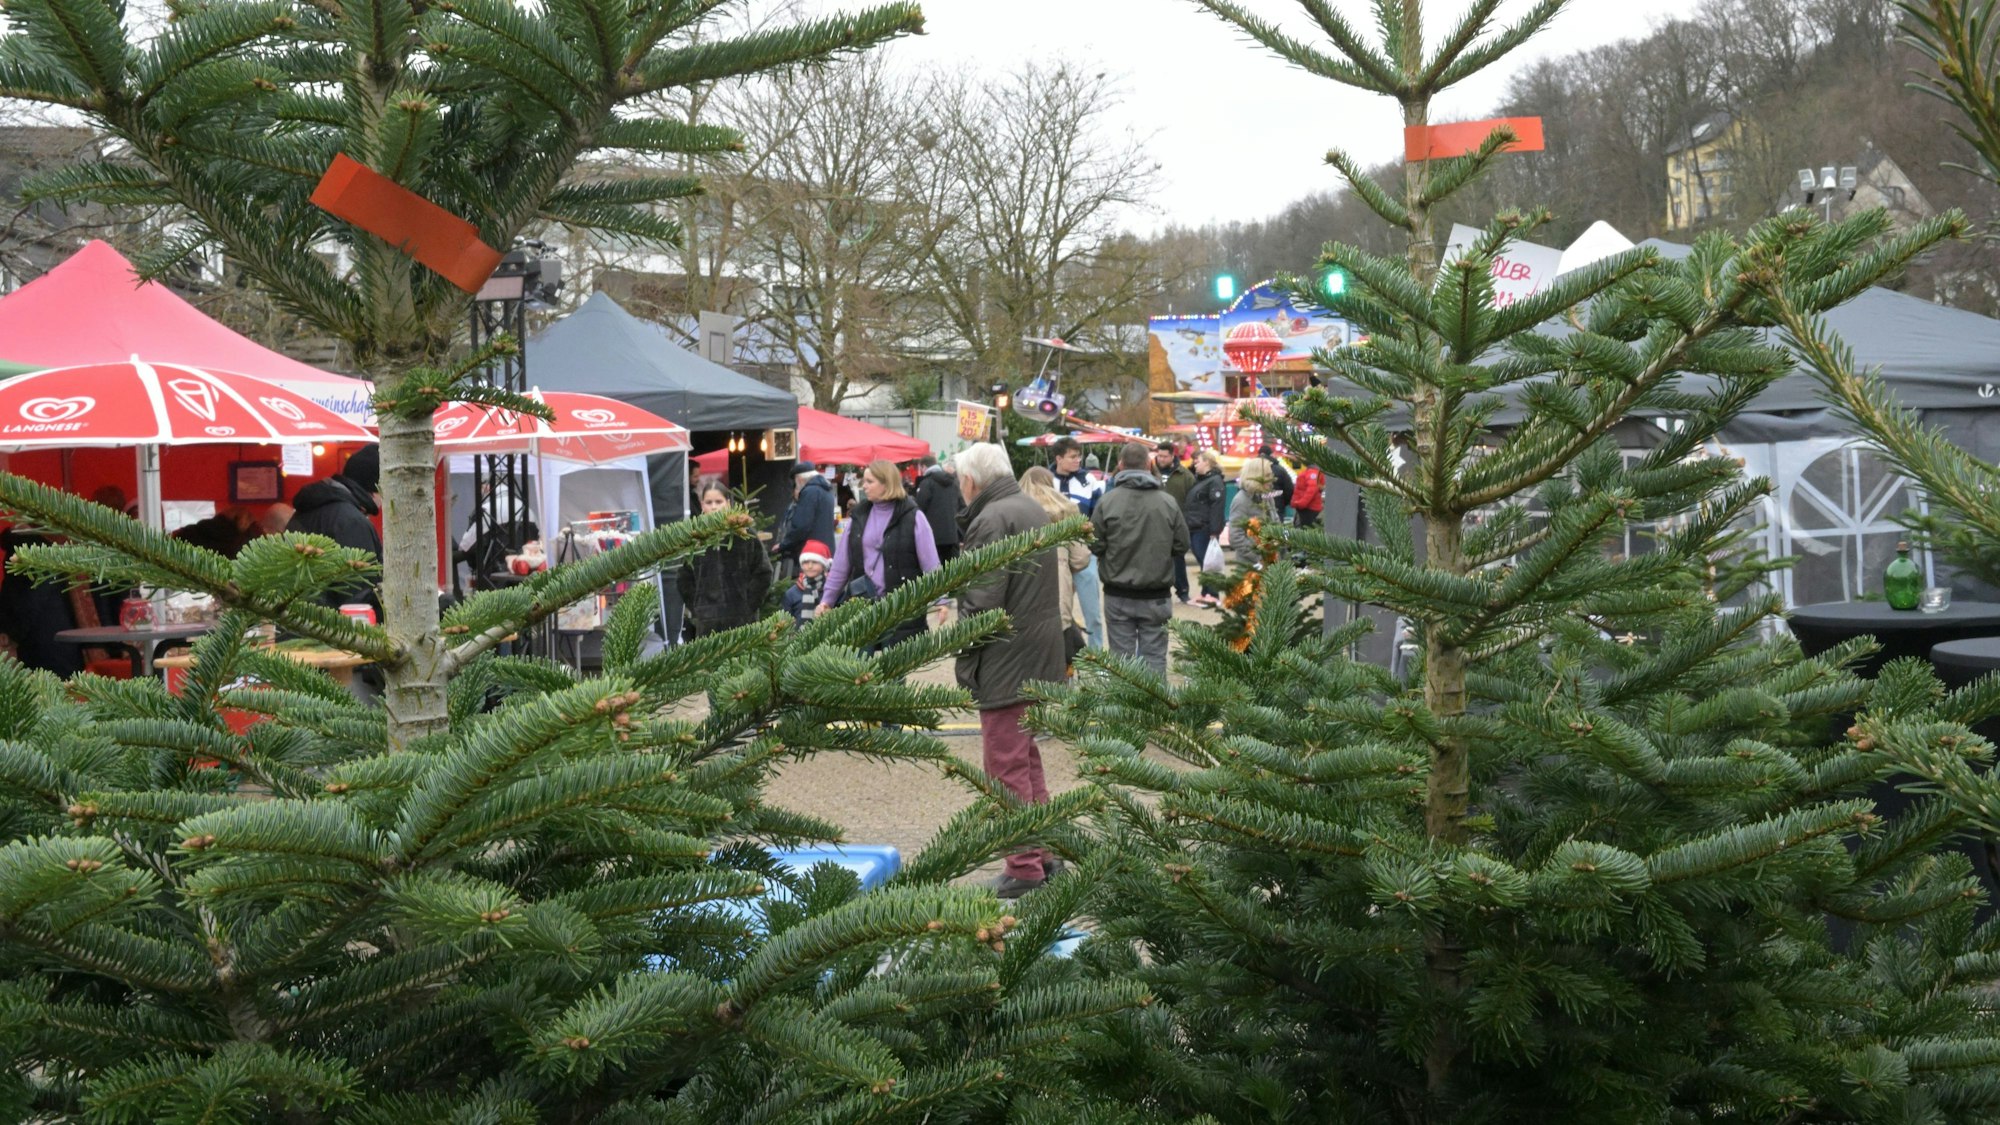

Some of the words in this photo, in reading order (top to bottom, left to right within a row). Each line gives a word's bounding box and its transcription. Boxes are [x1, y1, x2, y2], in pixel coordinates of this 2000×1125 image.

[1491, 255, 1531, 281] DLER
[311, 389, 374, 424] meinschaf
[2, 422, 82, 433] LANGNESE
